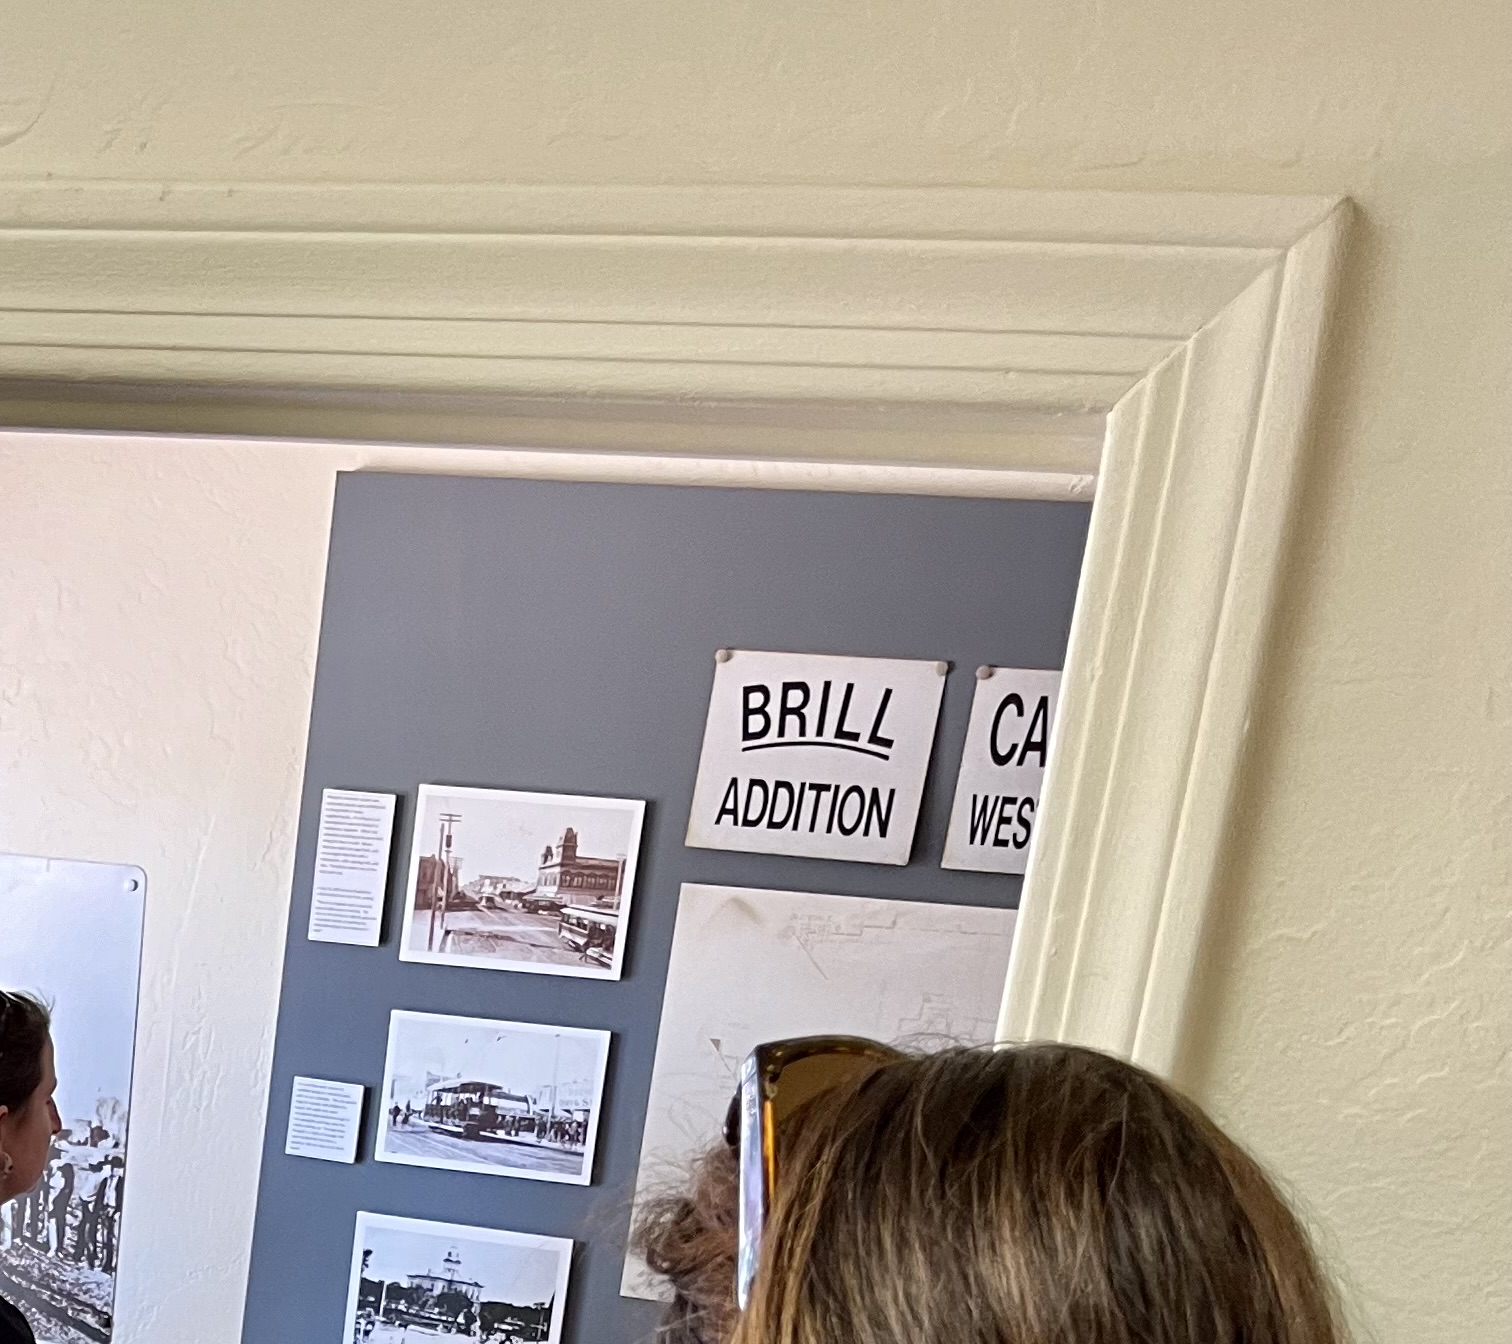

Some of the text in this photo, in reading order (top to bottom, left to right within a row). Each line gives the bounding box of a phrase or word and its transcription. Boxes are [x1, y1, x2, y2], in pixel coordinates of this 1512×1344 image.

[742, 680, 894, 750] BRILL
[714, 776, 896, 839] ADDITION
[969, 793, 1038, 849] WES
